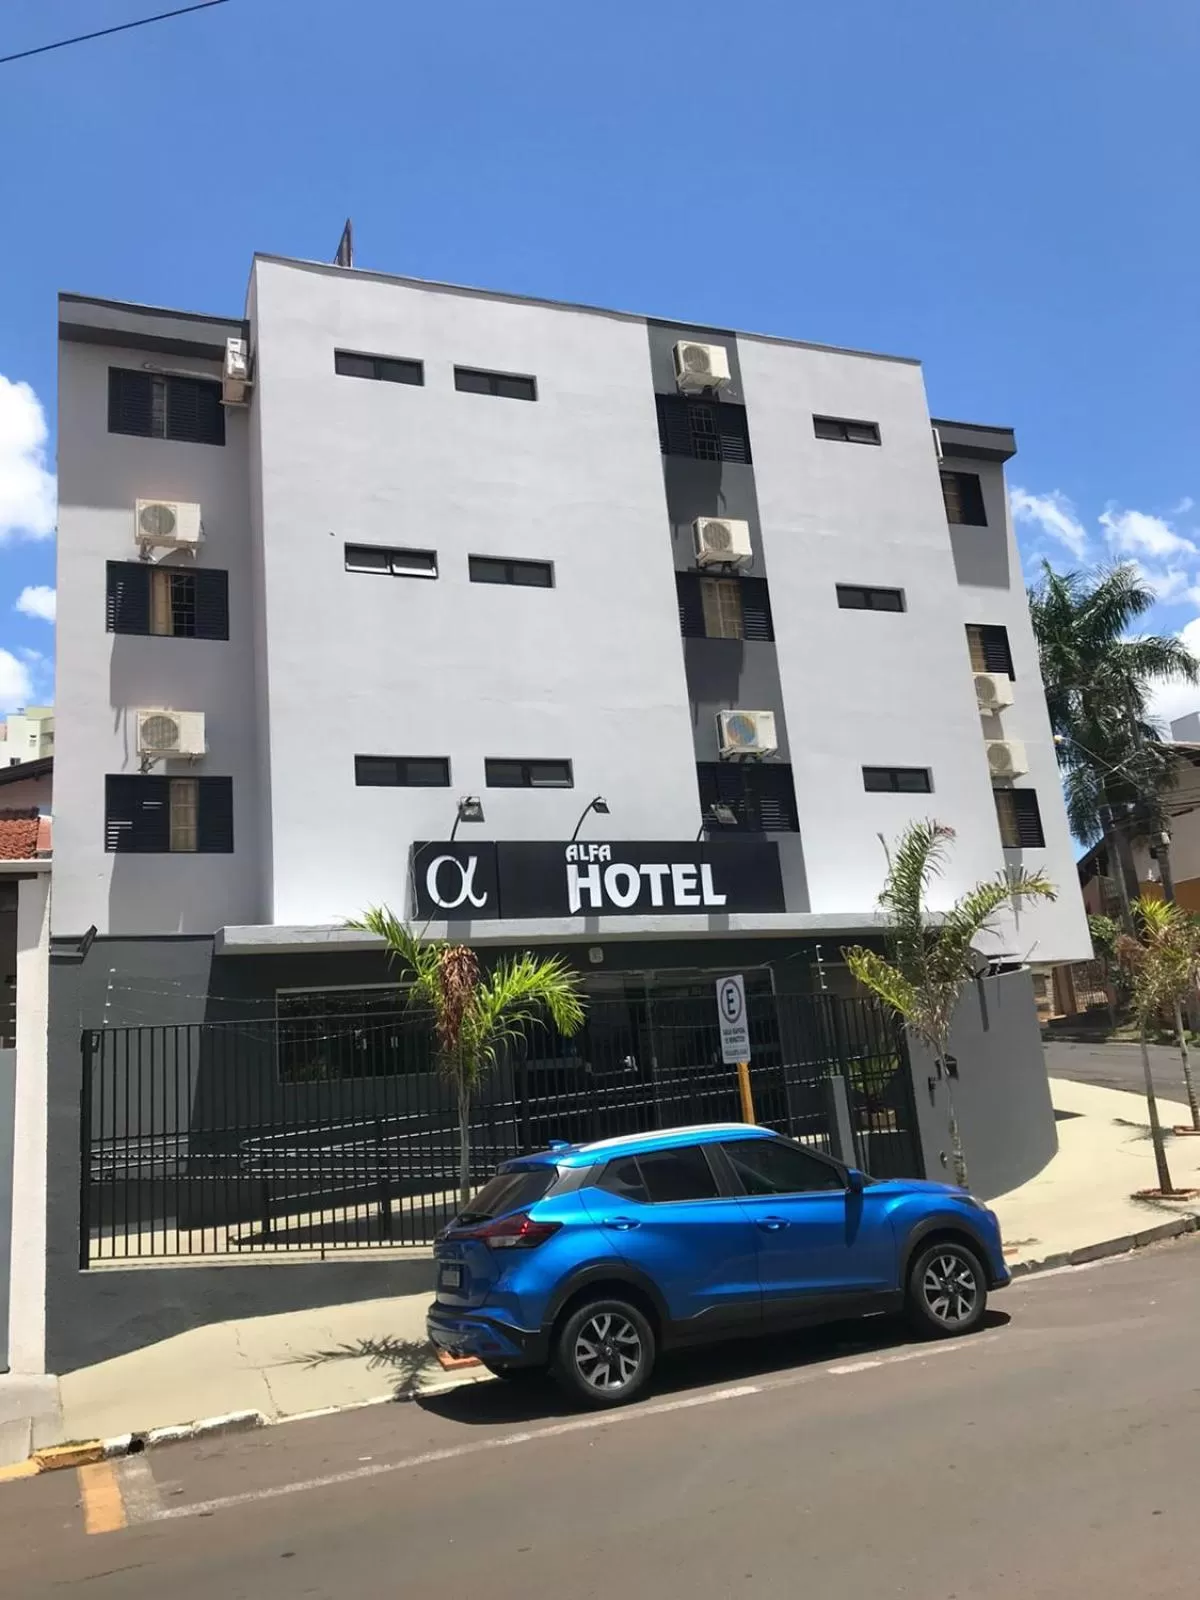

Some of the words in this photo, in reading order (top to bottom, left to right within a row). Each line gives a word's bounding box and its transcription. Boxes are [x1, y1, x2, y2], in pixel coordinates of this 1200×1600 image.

[565, 844, 611, 862] ALFA
[566, 863, 727, 914] HOTEL
[725, 988, 736, 1015] E
